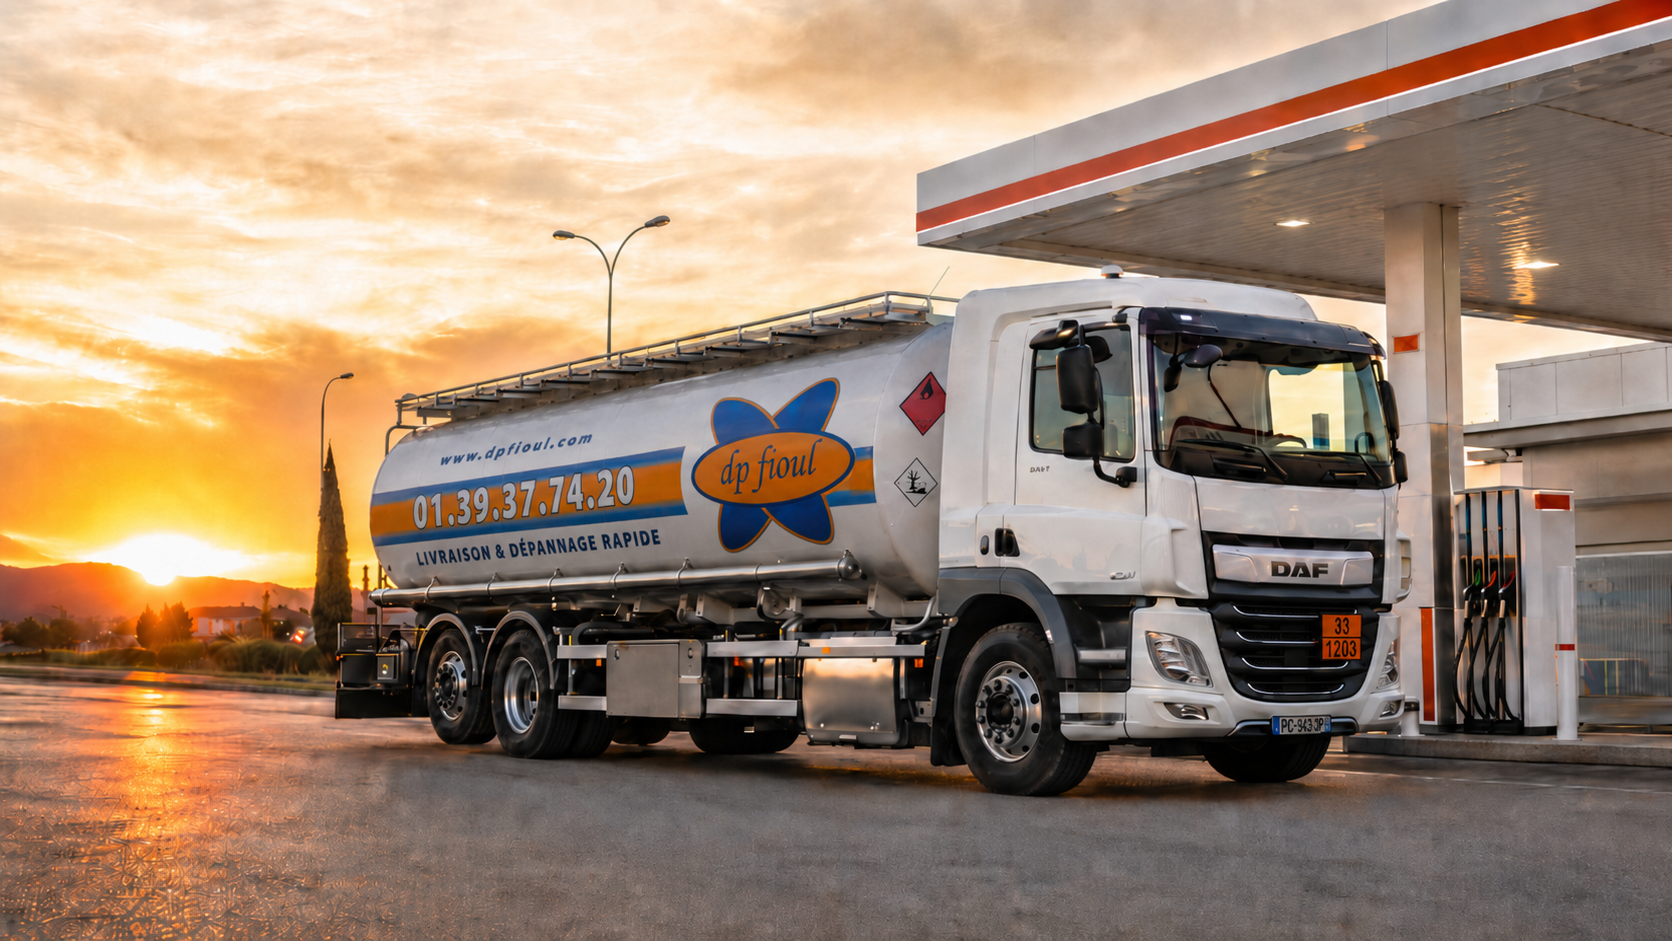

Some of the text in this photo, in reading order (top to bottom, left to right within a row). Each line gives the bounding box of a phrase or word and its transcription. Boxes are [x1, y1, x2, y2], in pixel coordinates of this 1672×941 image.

[440, 432, 593, 466] www.dpfioul.com
[721, 438, 823, 495] dp fioul
[412, 464, 635, 530] 01.39.37.74.20
[416, 528, 661, 566] LIVRAISON & DÉPANNAGE RAPIDE
[1271, 561, 1328, 578] DAF
[1335, 617, 1349, 635] 33
[1325, 640, 1357, 658] 1203
